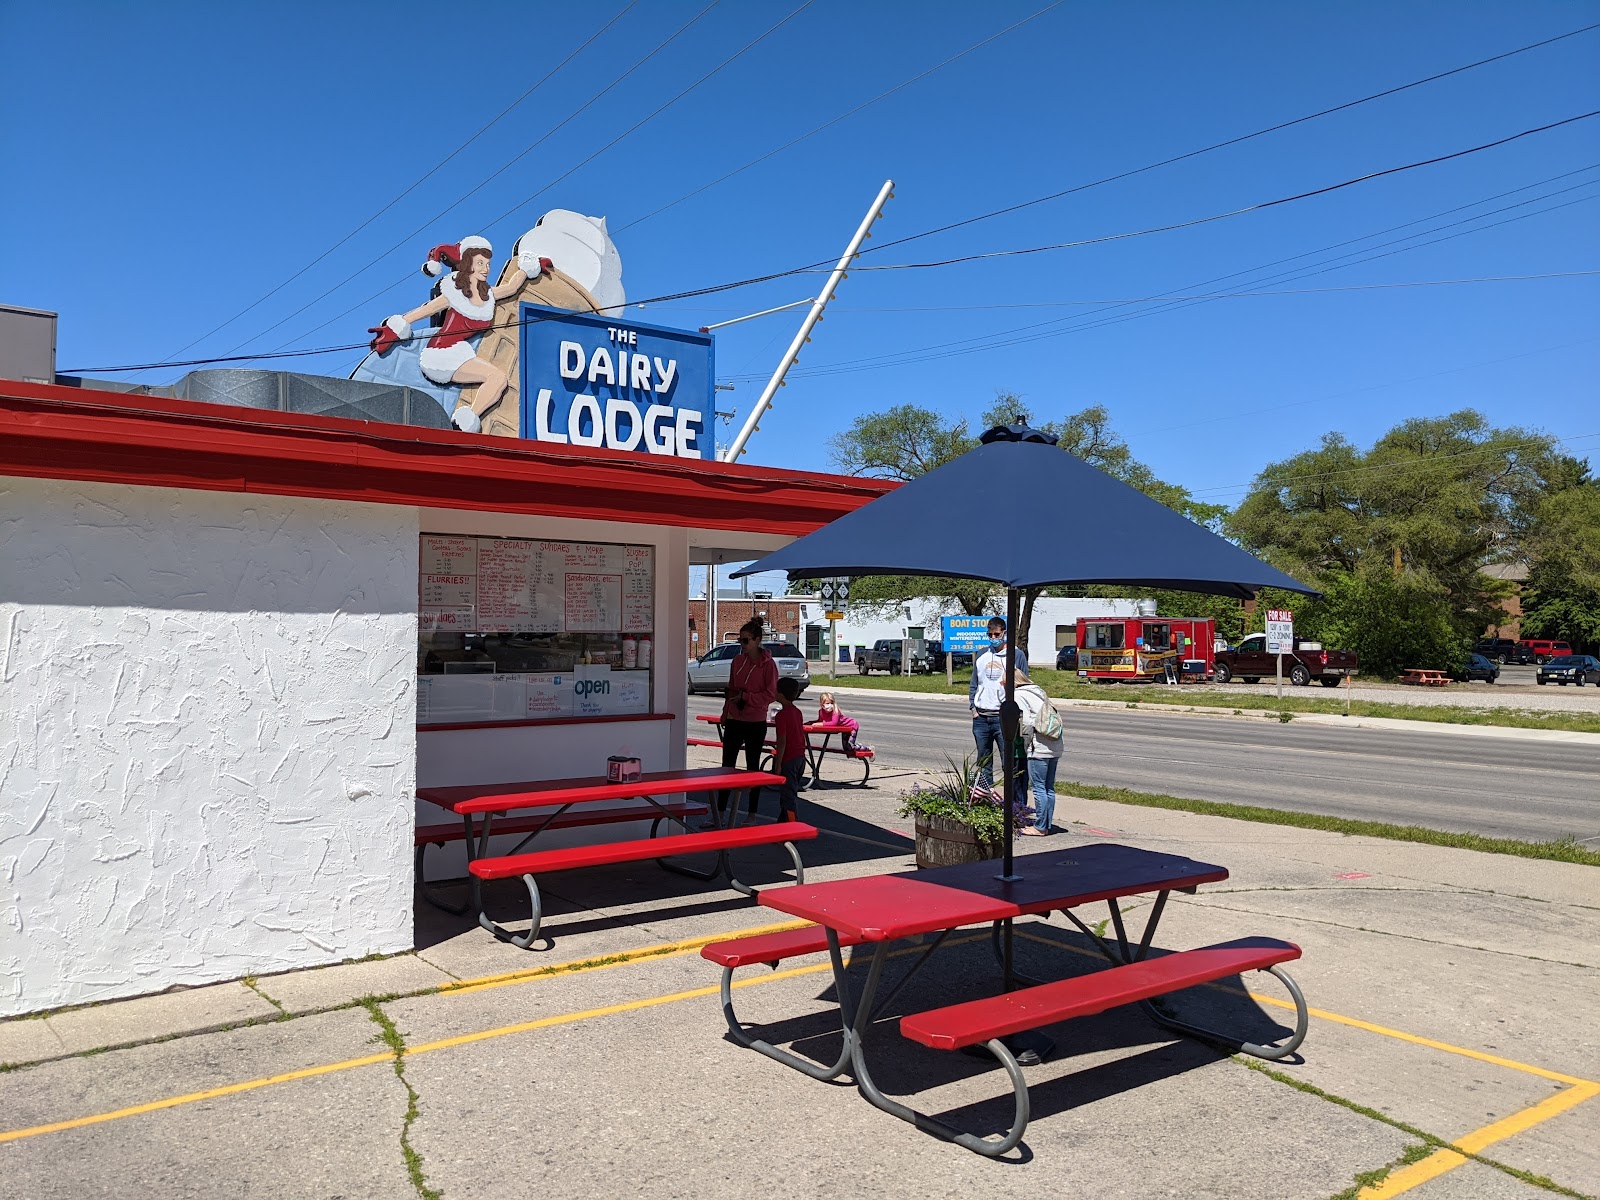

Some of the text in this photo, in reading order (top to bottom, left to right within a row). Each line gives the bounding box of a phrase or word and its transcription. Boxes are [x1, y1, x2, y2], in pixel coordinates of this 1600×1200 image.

[607, 327, 637, 345] THE
[560, 340, 677, 393] DAIRY
[535, 388, 702, 459] LODGE
[428, 576, 470, 585] FLURRIES!!
[950, 619, 970, 628] BOAT
[1268, 610, 1292, 621] FOR SALE
[574, 680, 610, 699] open
